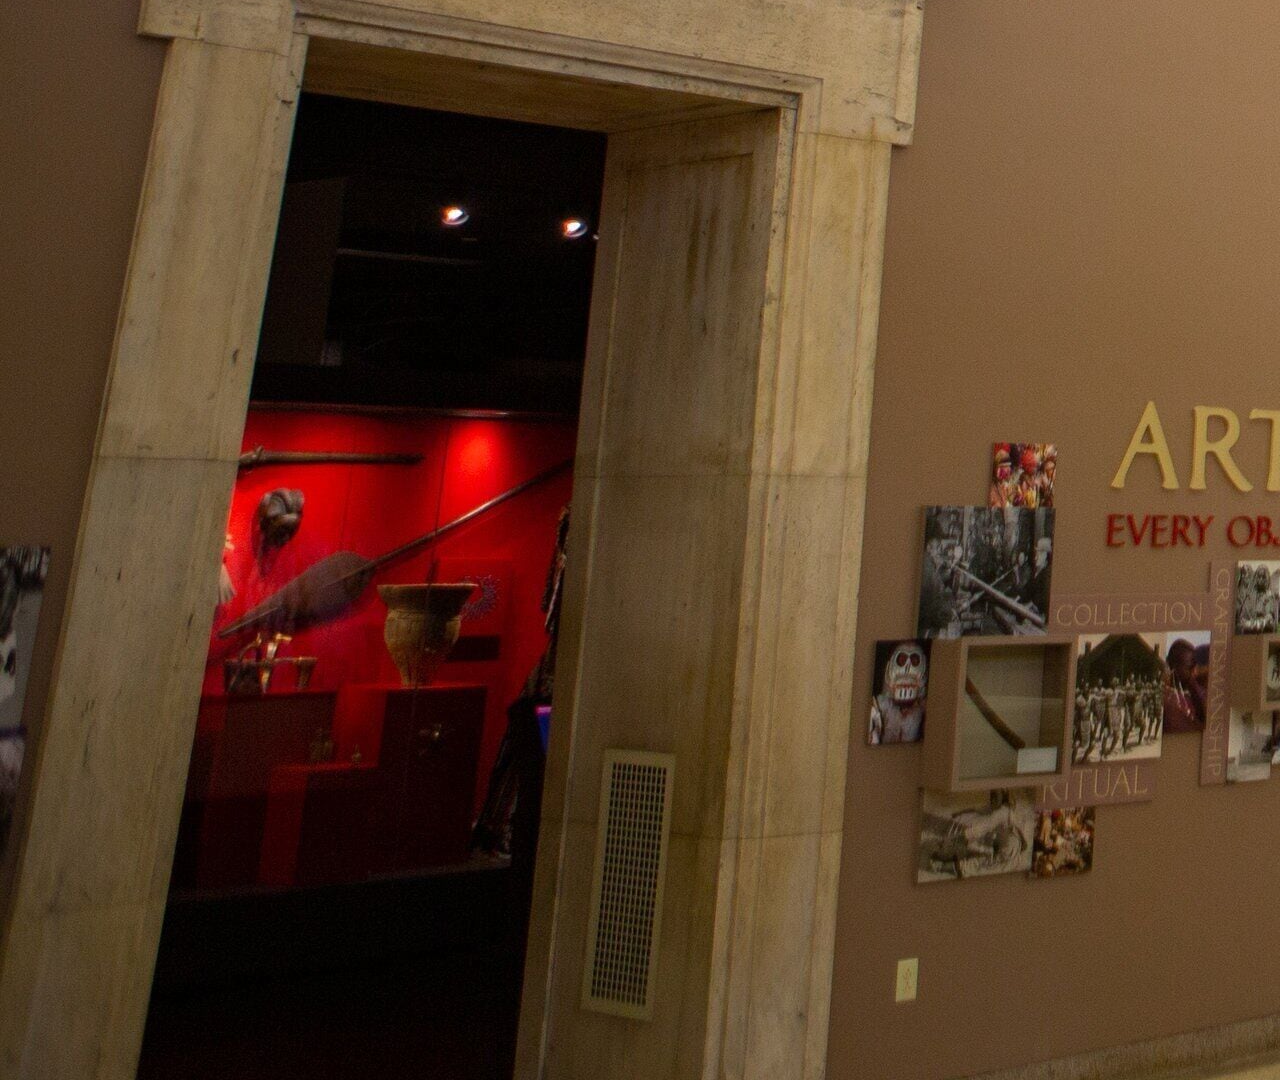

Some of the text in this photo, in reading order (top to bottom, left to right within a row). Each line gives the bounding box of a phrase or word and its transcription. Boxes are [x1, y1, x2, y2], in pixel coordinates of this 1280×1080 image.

[1104, 513, 1215, 548] EVERY
[1056, 601, 1204, 628] COLLECTION
[1206, 567, 1231, 778] CRAFTSMANSHIP
